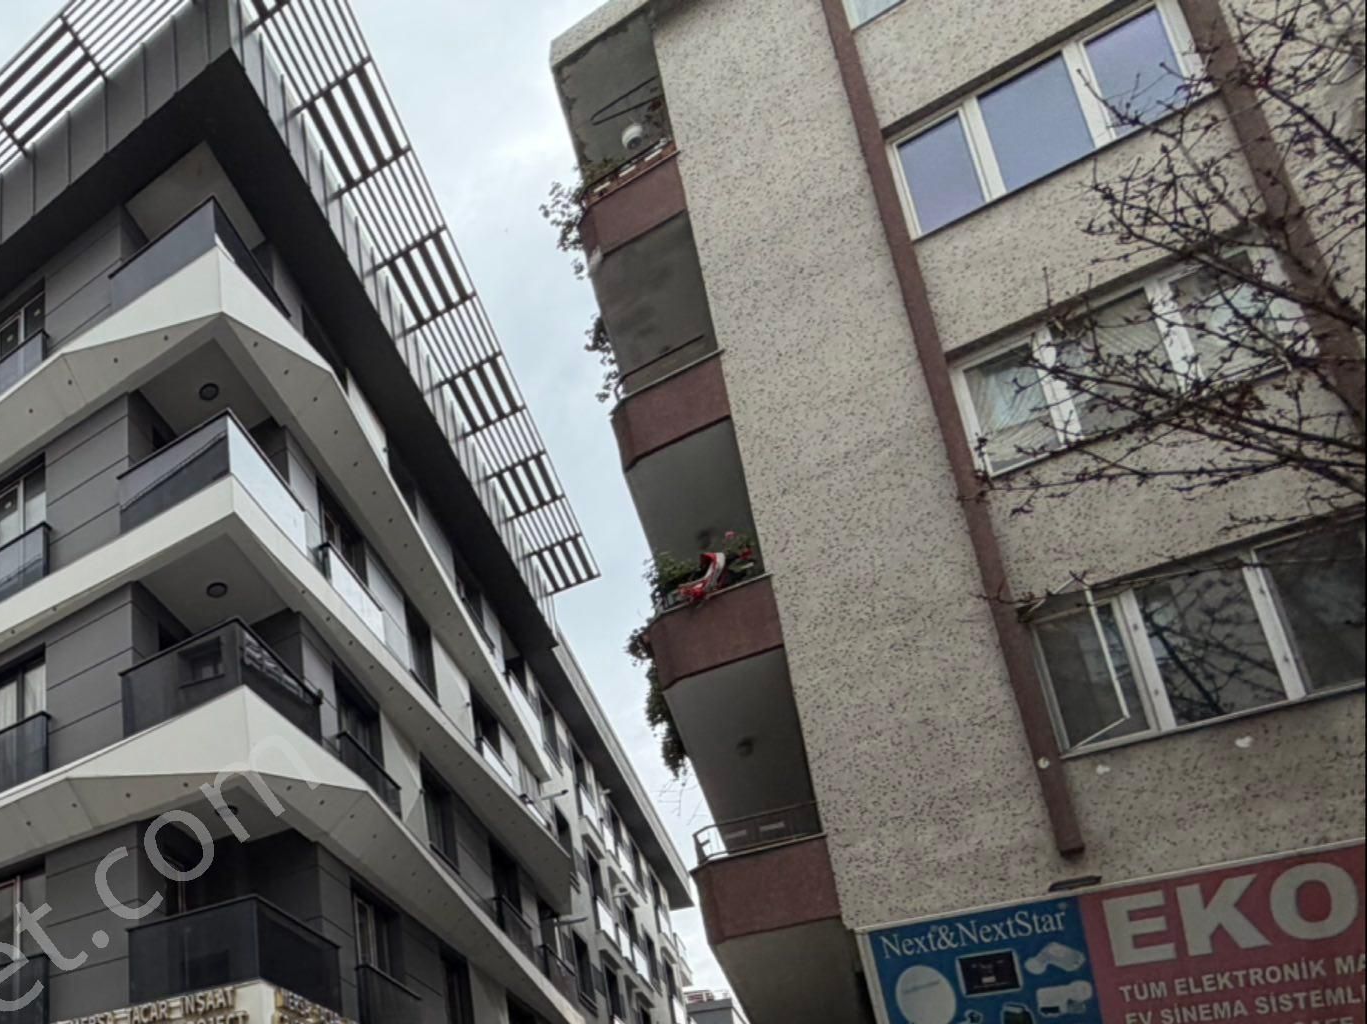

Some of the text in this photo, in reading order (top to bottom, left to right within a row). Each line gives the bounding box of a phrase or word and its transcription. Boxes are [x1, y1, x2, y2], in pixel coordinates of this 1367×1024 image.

[880, 909, 1066, 959] Next&NextStar
[1102, 862, 1358, 966] EKO
[1175, 957, 1326, 996] ELEKTRONİK
